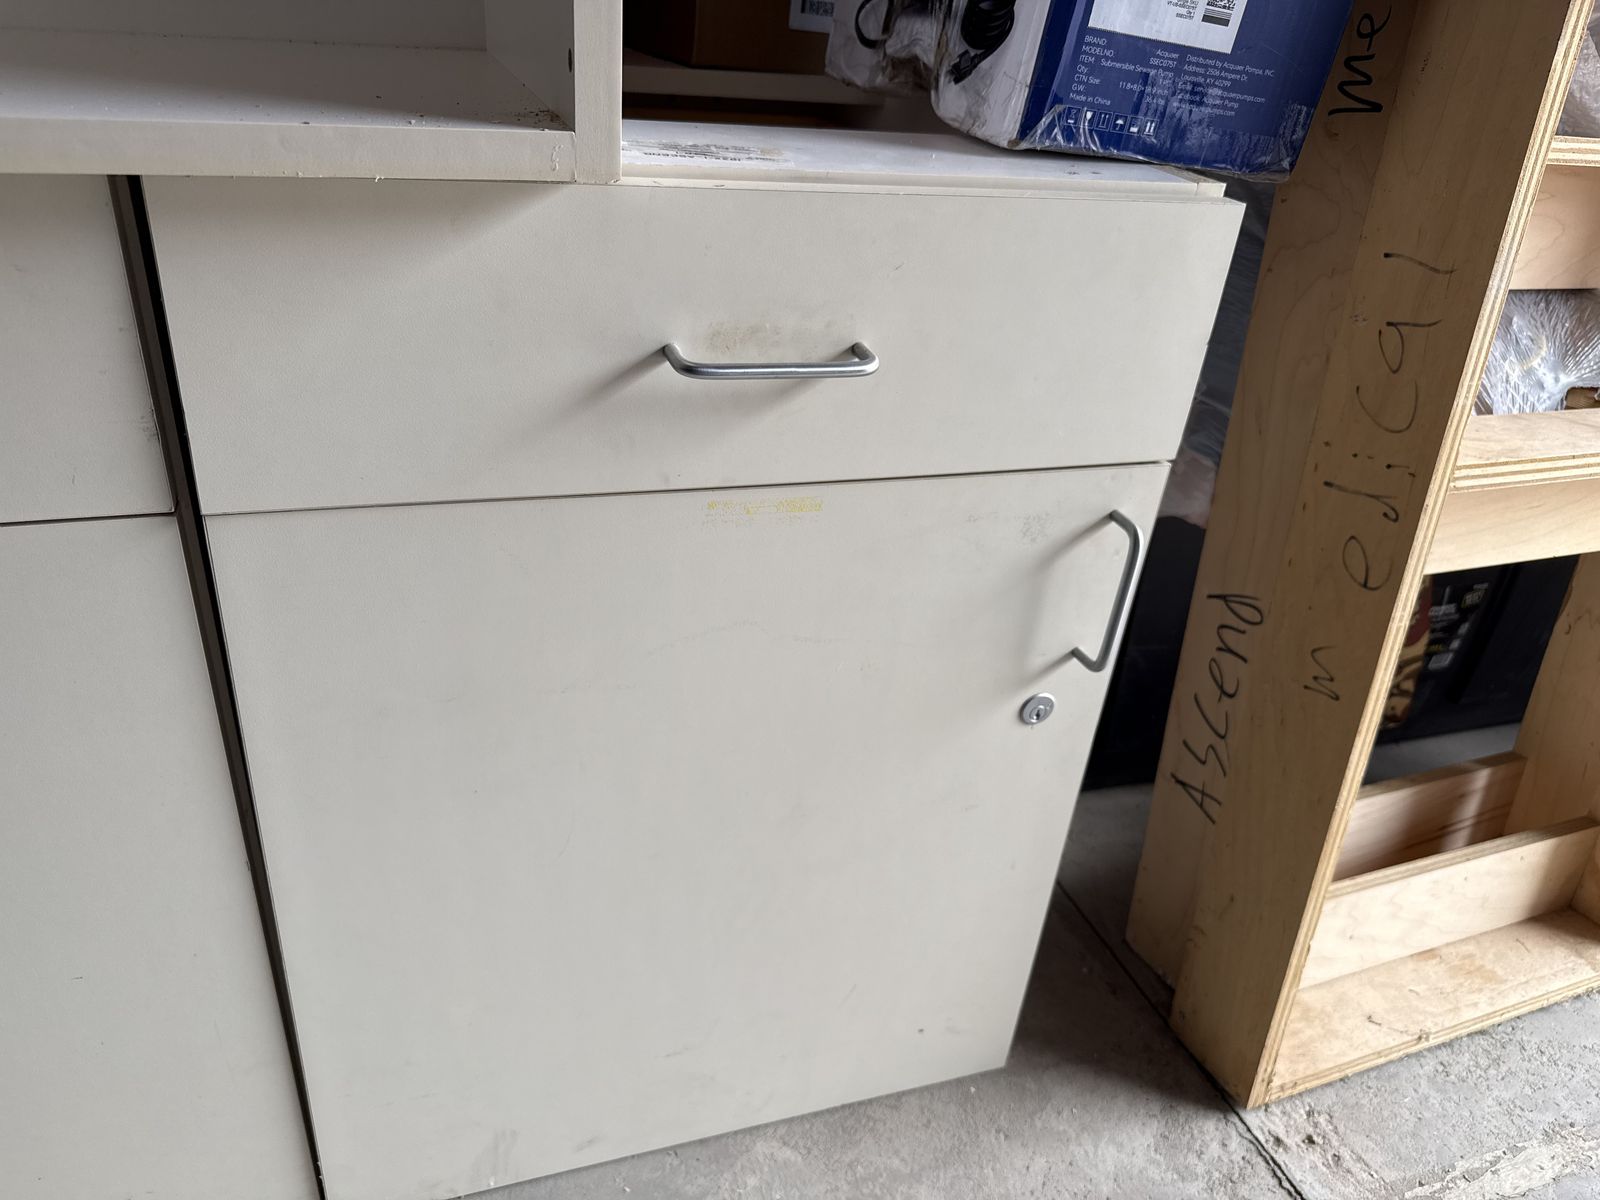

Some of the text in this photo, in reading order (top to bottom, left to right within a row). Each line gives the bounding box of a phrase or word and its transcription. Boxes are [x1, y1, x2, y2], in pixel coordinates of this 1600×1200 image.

[1100, 58, 1135, 70] Submersible
[1186, 54, 1216, 66] Distributed
[1215, 59, 1222, 69] by
[1074, 73, 1088, 83] CTN
[1220, 70, 1241, 81] Ampere
[1070, 93, 1087, 102] Made
[1094, 97, 1111, 106] China
